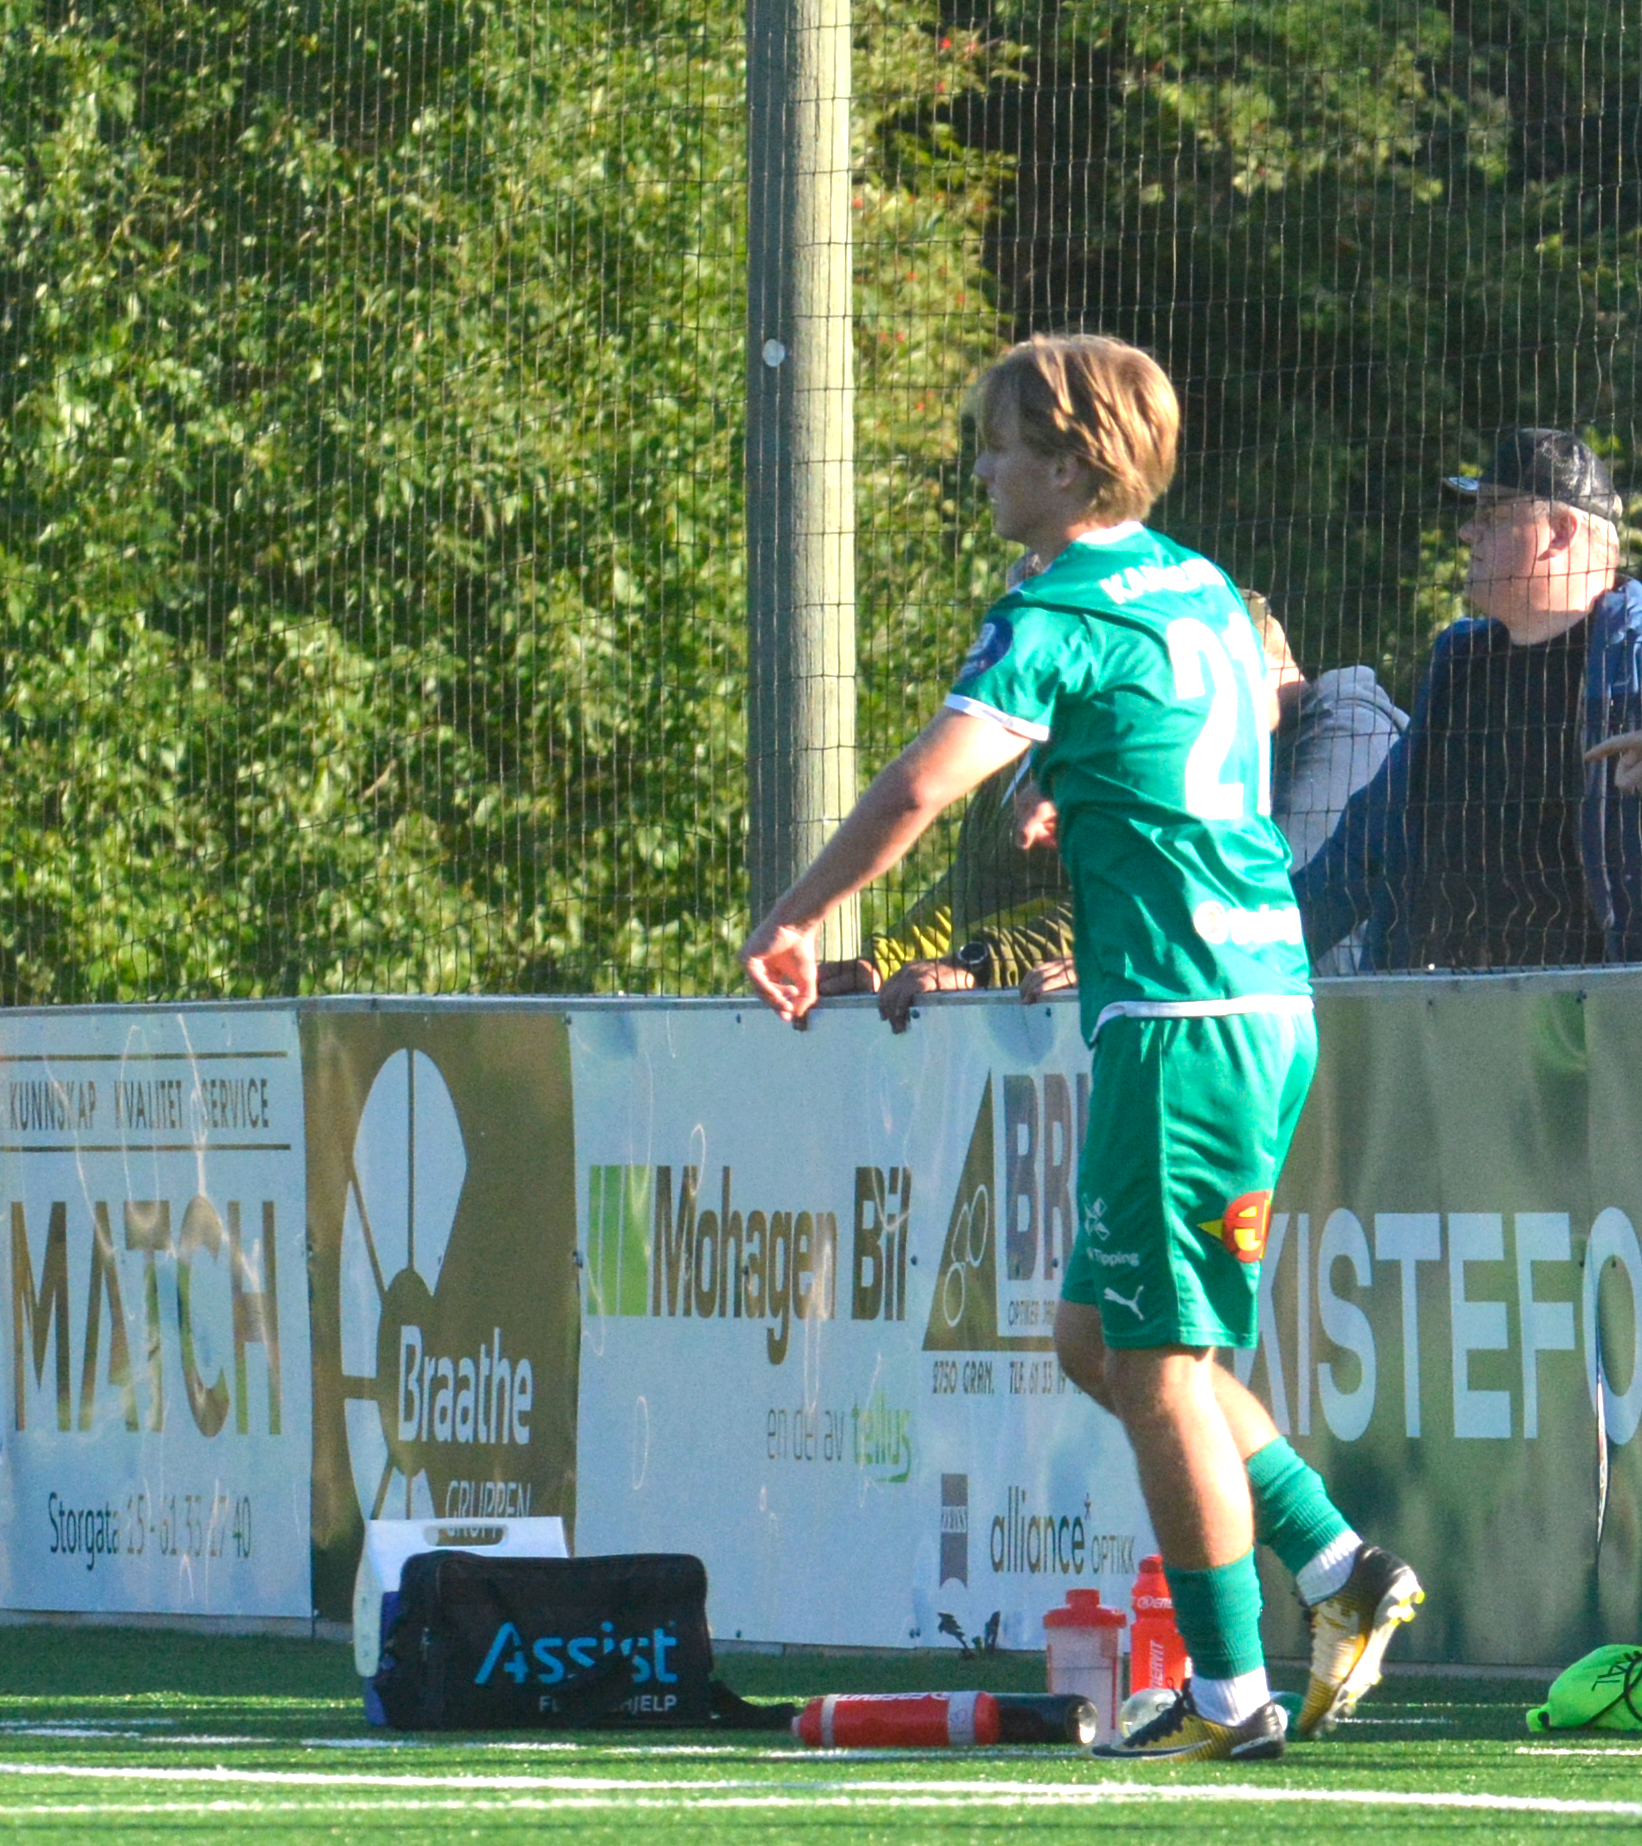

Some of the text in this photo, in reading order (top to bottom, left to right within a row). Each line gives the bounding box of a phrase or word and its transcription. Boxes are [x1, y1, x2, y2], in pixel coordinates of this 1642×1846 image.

[201, 1078, 269, 1128] SERVICE
[652, 1166, 912, 1365] Mohagen Bil
[12, 1200, 281, 1437] MATCH
[398, 1326, 533, 1444] Braathe
[768, 1409, 787, 1459] en
[824, 1410, 844, 1461] av
[49, 1492, 119, 1571] Storgata
[233, 1497, 251, 1558] 40
[990, 1486, 1085, 1574] alliance
[1092, 1535, 1135, 1574] OPTIKK
[1149, 1639, 1165, 1690] NERVIT
